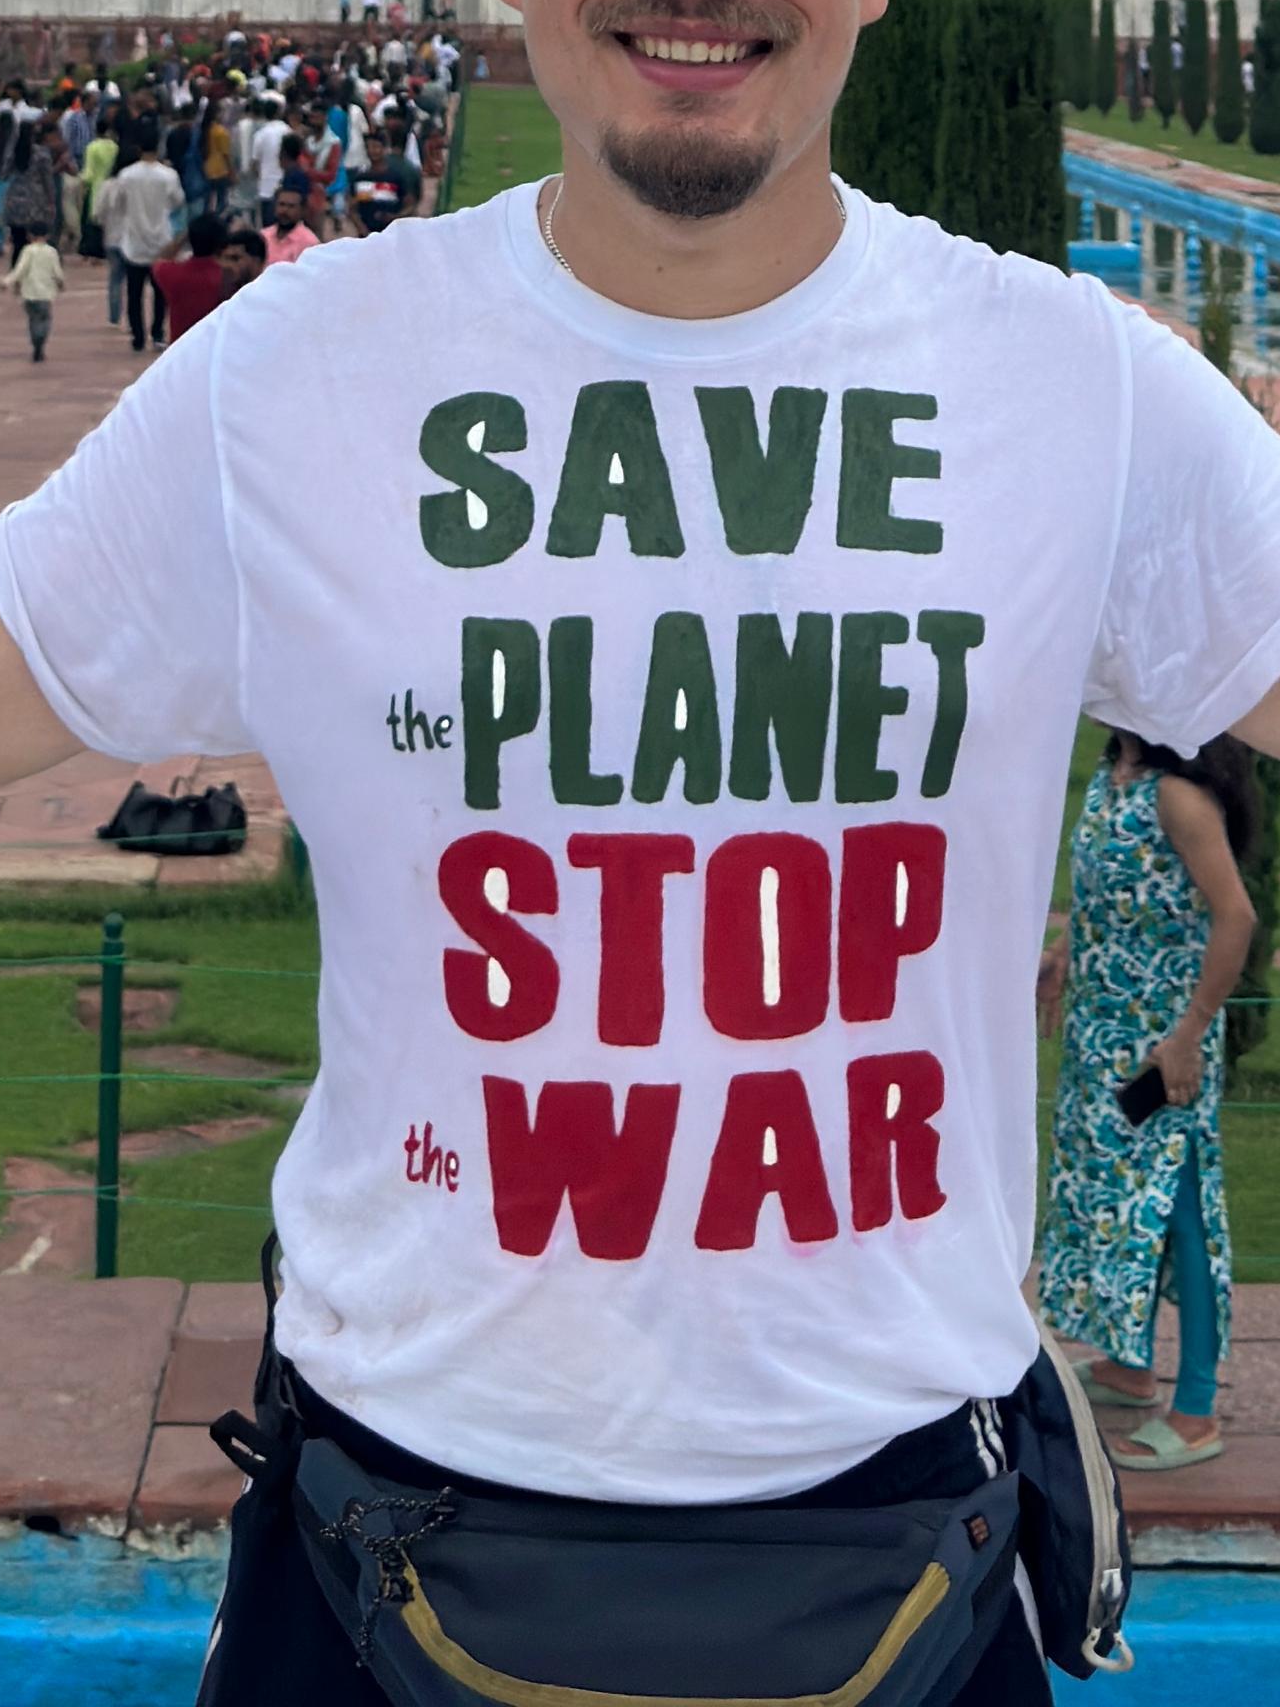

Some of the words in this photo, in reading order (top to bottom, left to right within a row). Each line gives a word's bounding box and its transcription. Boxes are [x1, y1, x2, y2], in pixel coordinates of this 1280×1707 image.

[419, 381, 943, 568] SAVE
[386, 689, 453, 752] the
[461, 610, 985, 810] PLANET
[438, 821, 947, 1047] STOP
[404, 1122, 459, 1192] the
[482, 1049, 946, 1260] WAR
